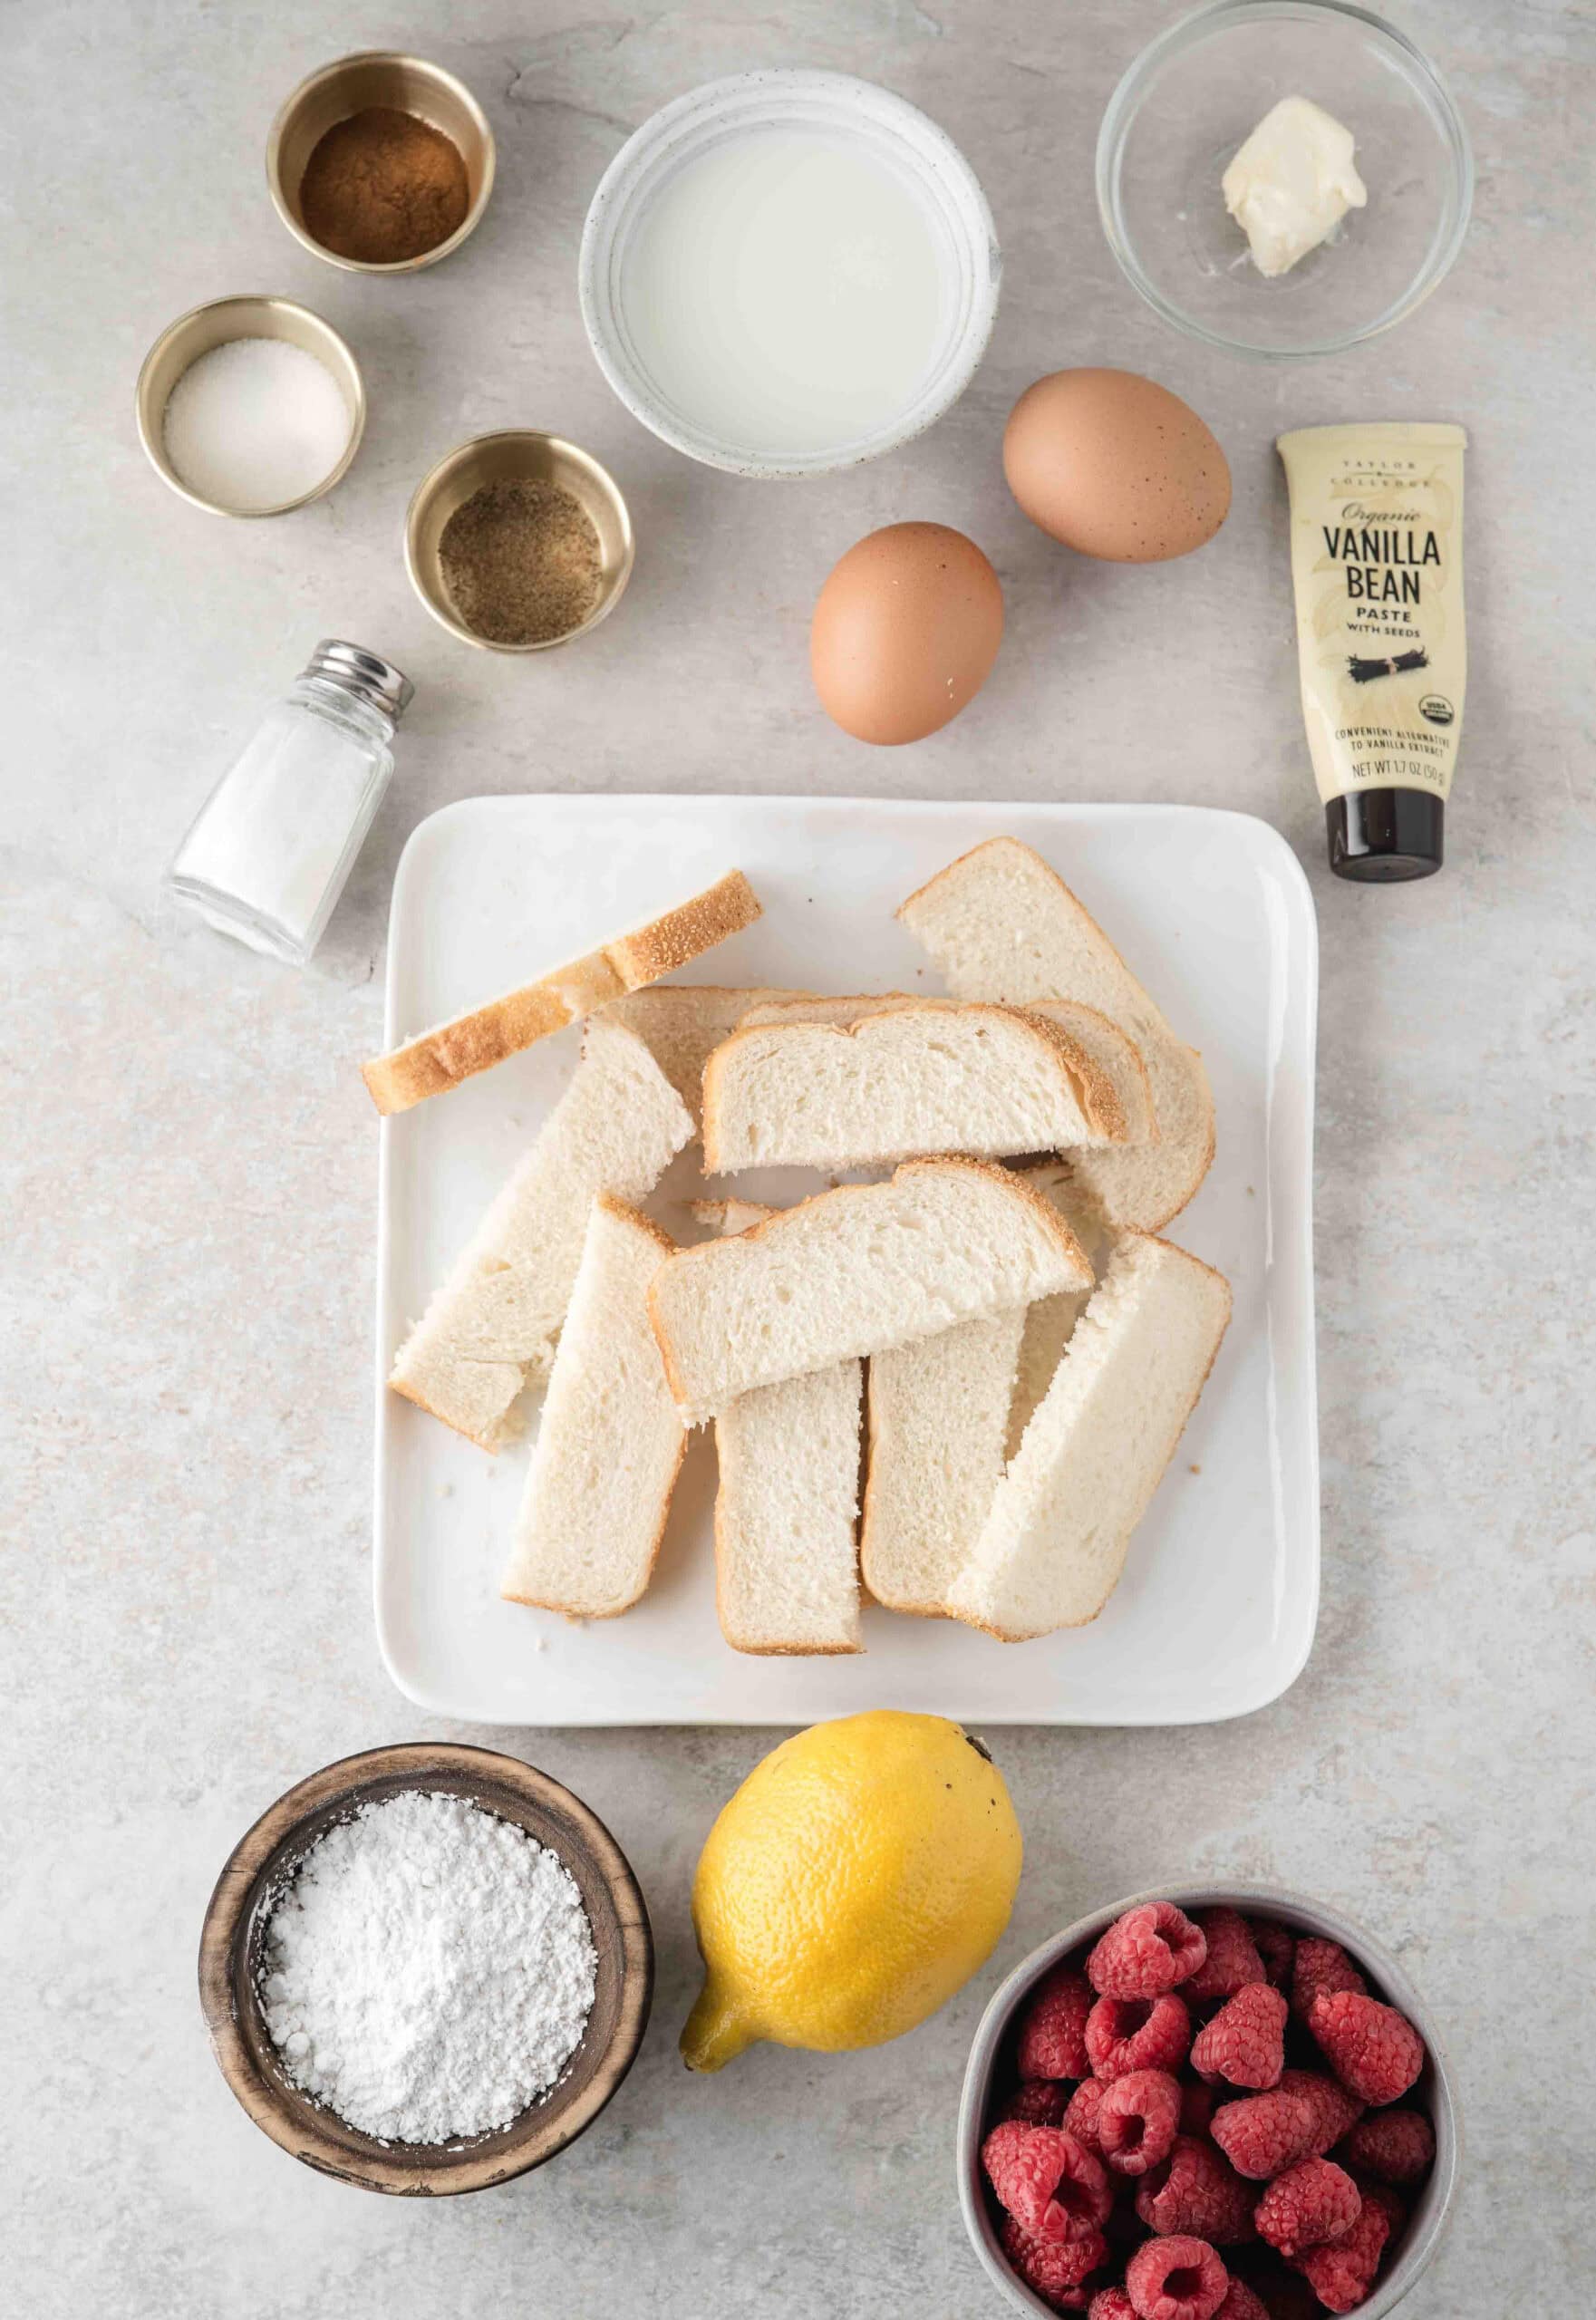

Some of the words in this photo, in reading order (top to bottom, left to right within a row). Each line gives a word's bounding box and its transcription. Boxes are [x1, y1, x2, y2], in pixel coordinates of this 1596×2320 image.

[1343, 460, 1416, 469] TAYLOR
[1341, 502, 1421, 530] Organic
[1322, 526, 1441, 566] VANILLA
[1346, 566, 1420, 604] BEAN
[1356, 607, 1412, 623] PASTE
[1347, 623, 1380, 633] WITH
[1384, 627, 1420, 638] SEEDS
[1335, 727, 1392, 740] CONVENIENT
[1351, 740, 1362, 750] TO
[1367, 739, 1405, 749] VANILLA
[1352, 761, 1371, 778] NET
[1374, 760, 1390, 775] WT
[1394, 759, 1406, 774] 1.7
[1408, 761, 1421, 776] OZ
